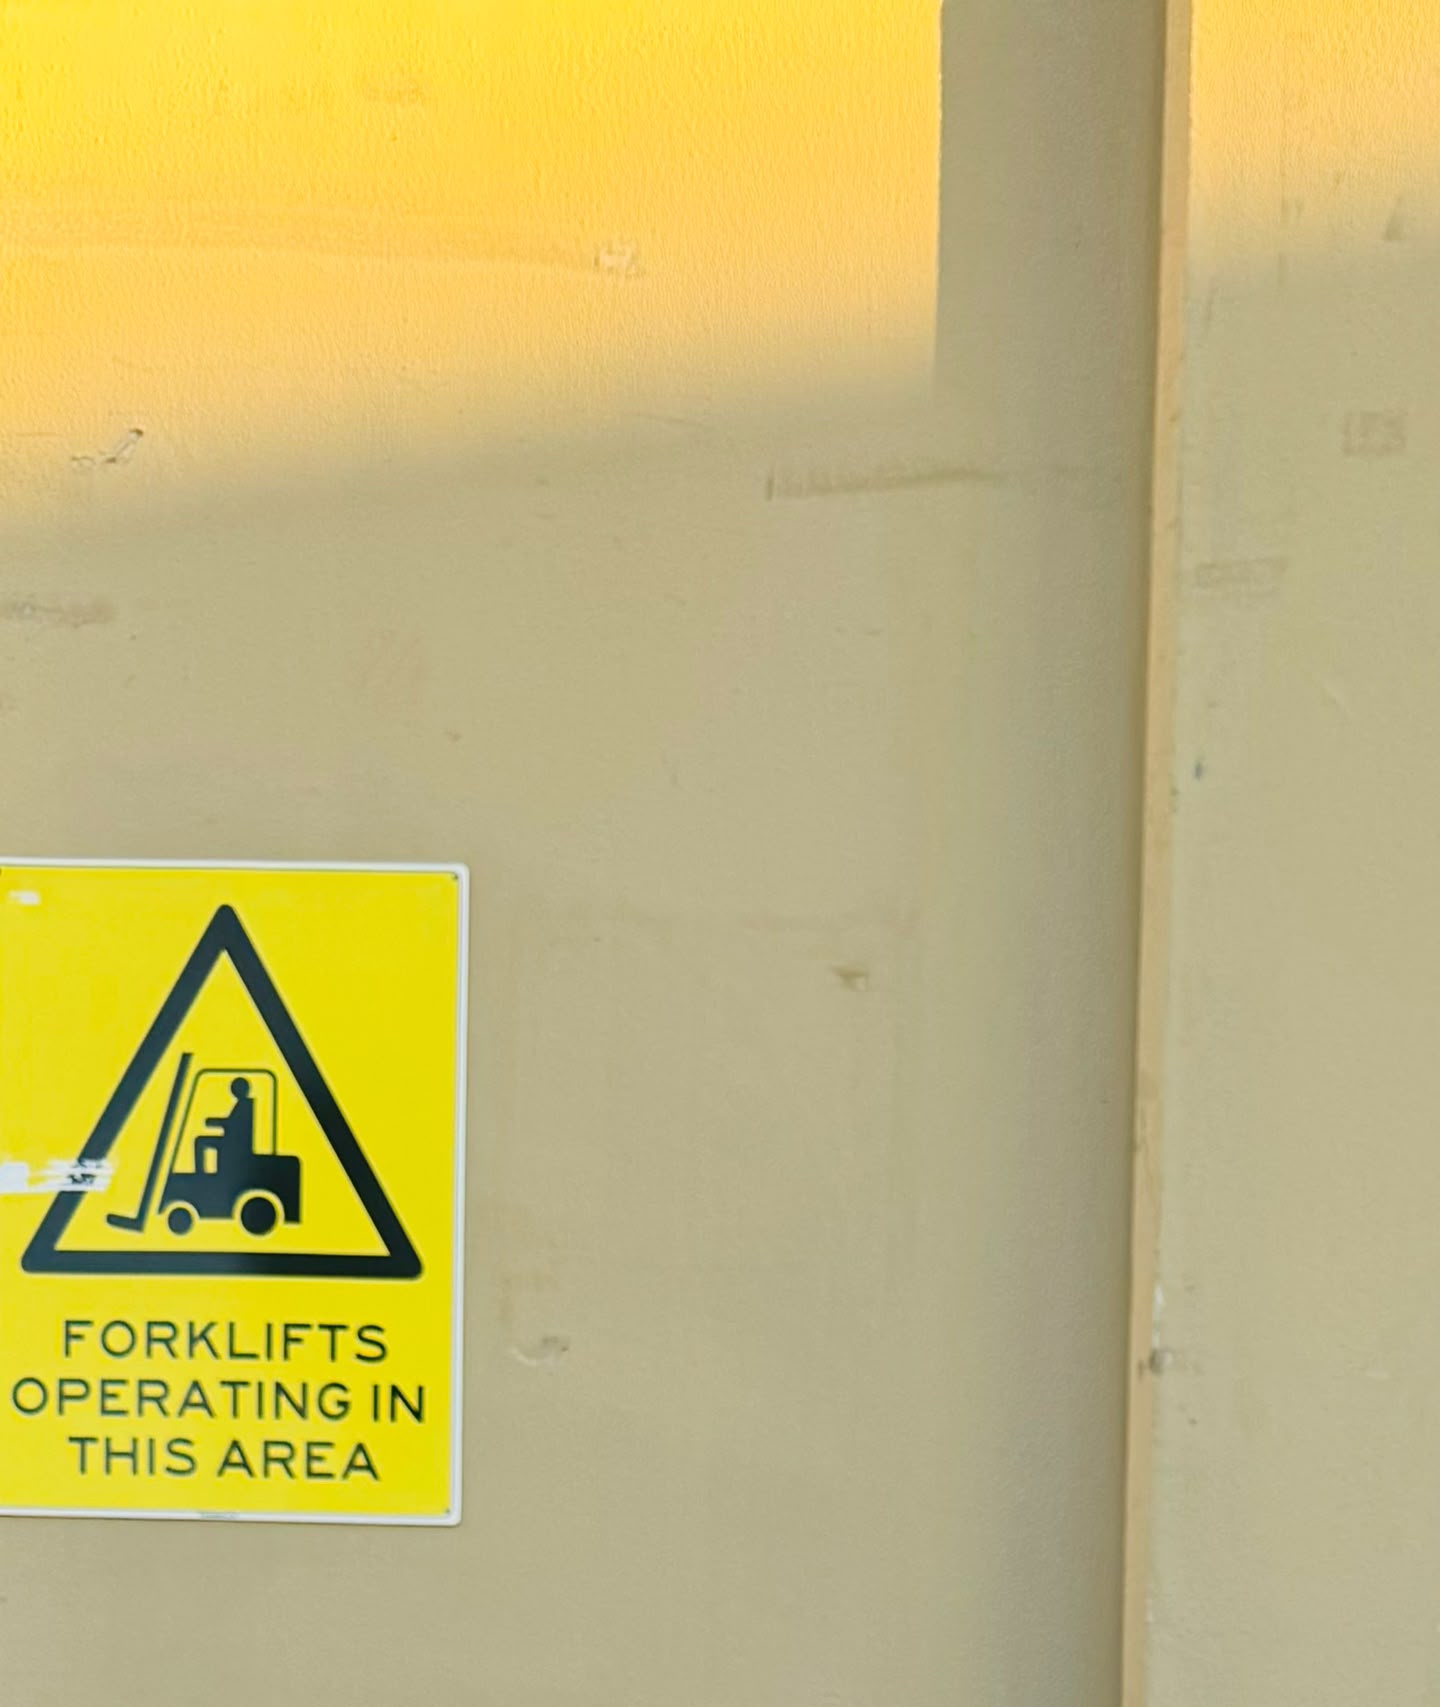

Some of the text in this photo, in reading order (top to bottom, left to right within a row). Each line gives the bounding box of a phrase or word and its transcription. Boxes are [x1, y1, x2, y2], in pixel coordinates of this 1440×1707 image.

[63, 1319, 388, 1364] FORKLIFTS
[12, 1377, 425, 1423] OPERATING IN
[68, 1436, 380, 1481] THIS AREA
